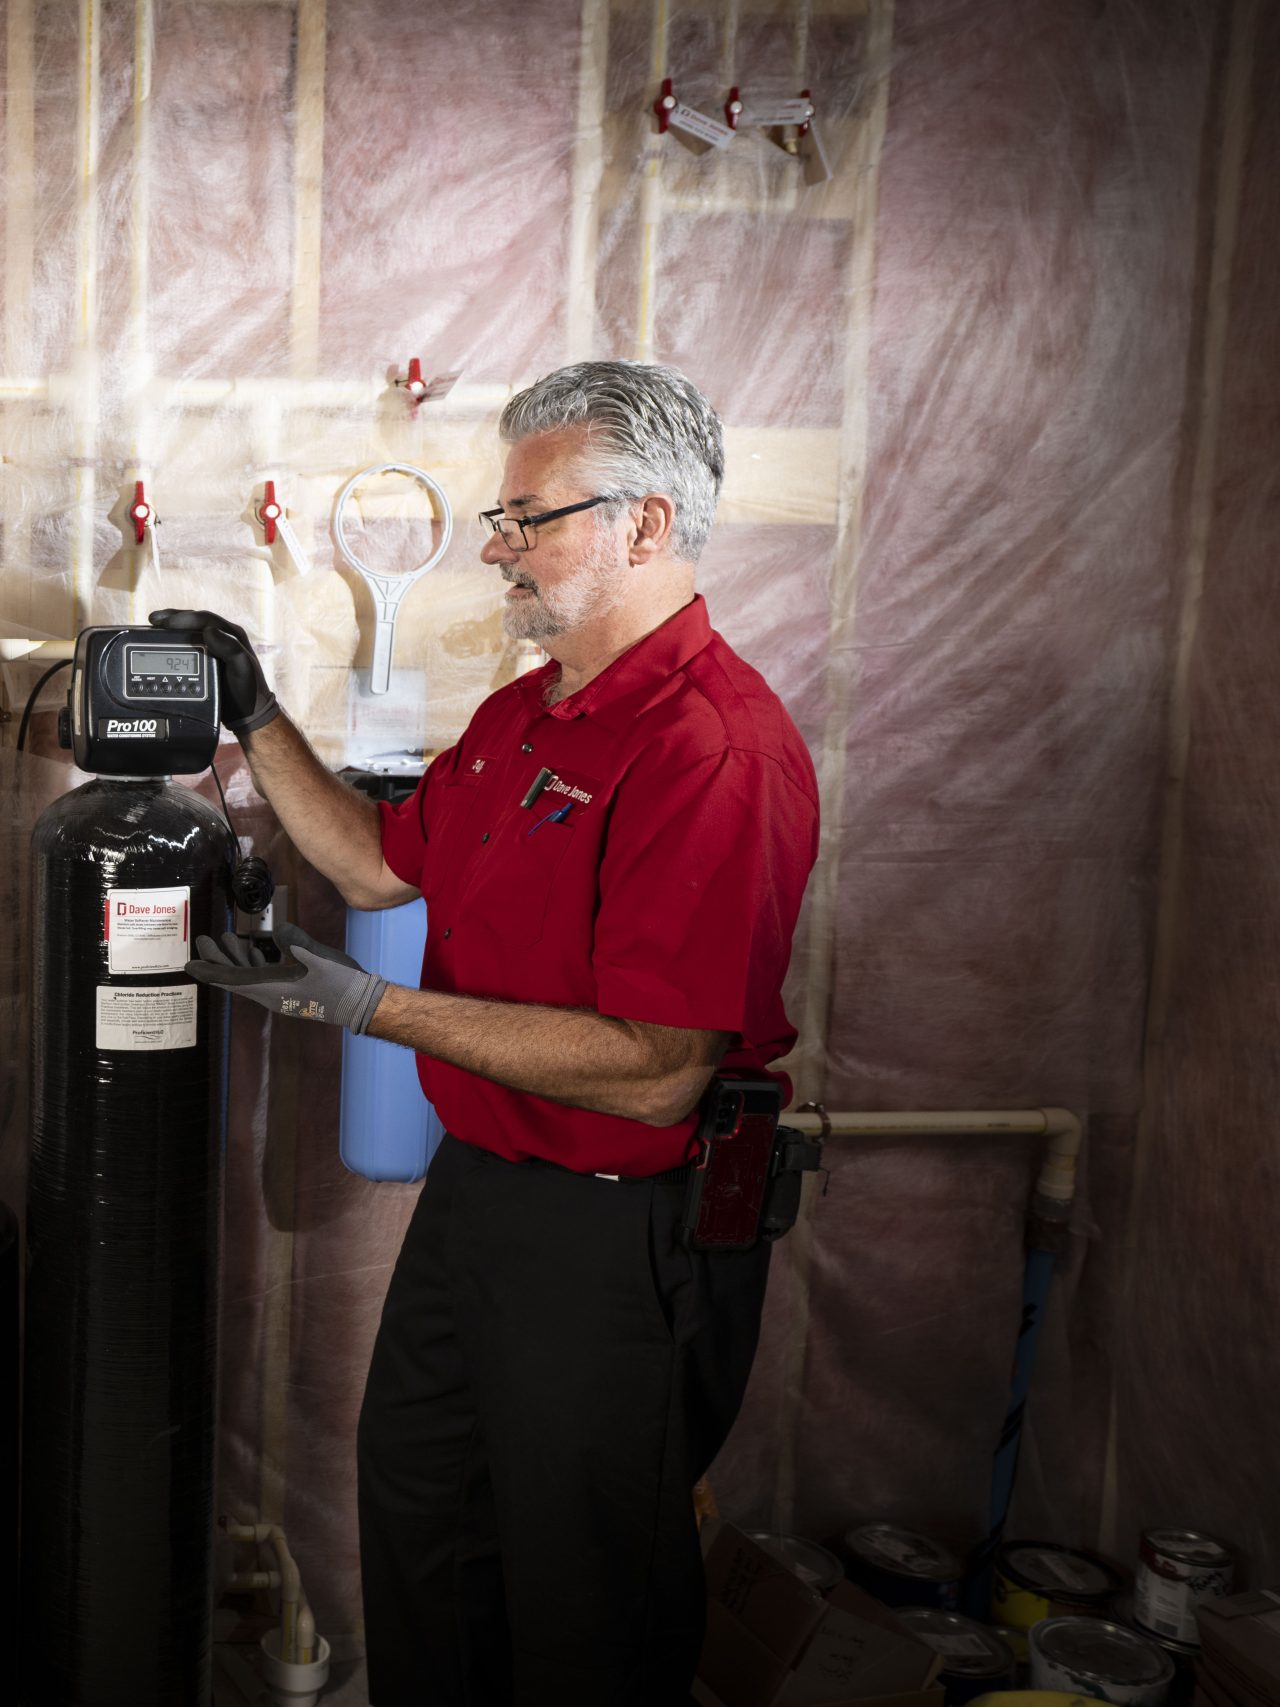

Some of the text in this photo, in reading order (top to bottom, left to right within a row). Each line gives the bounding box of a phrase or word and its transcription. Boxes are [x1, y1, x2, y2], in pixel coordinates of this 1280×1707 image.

[166, 657, 190, 671] 924
[107, 719, 157, 732] Pro100
[553, 780, 593, 804] Dave Jones
[129, 904, 177, 914] Dave Jones
